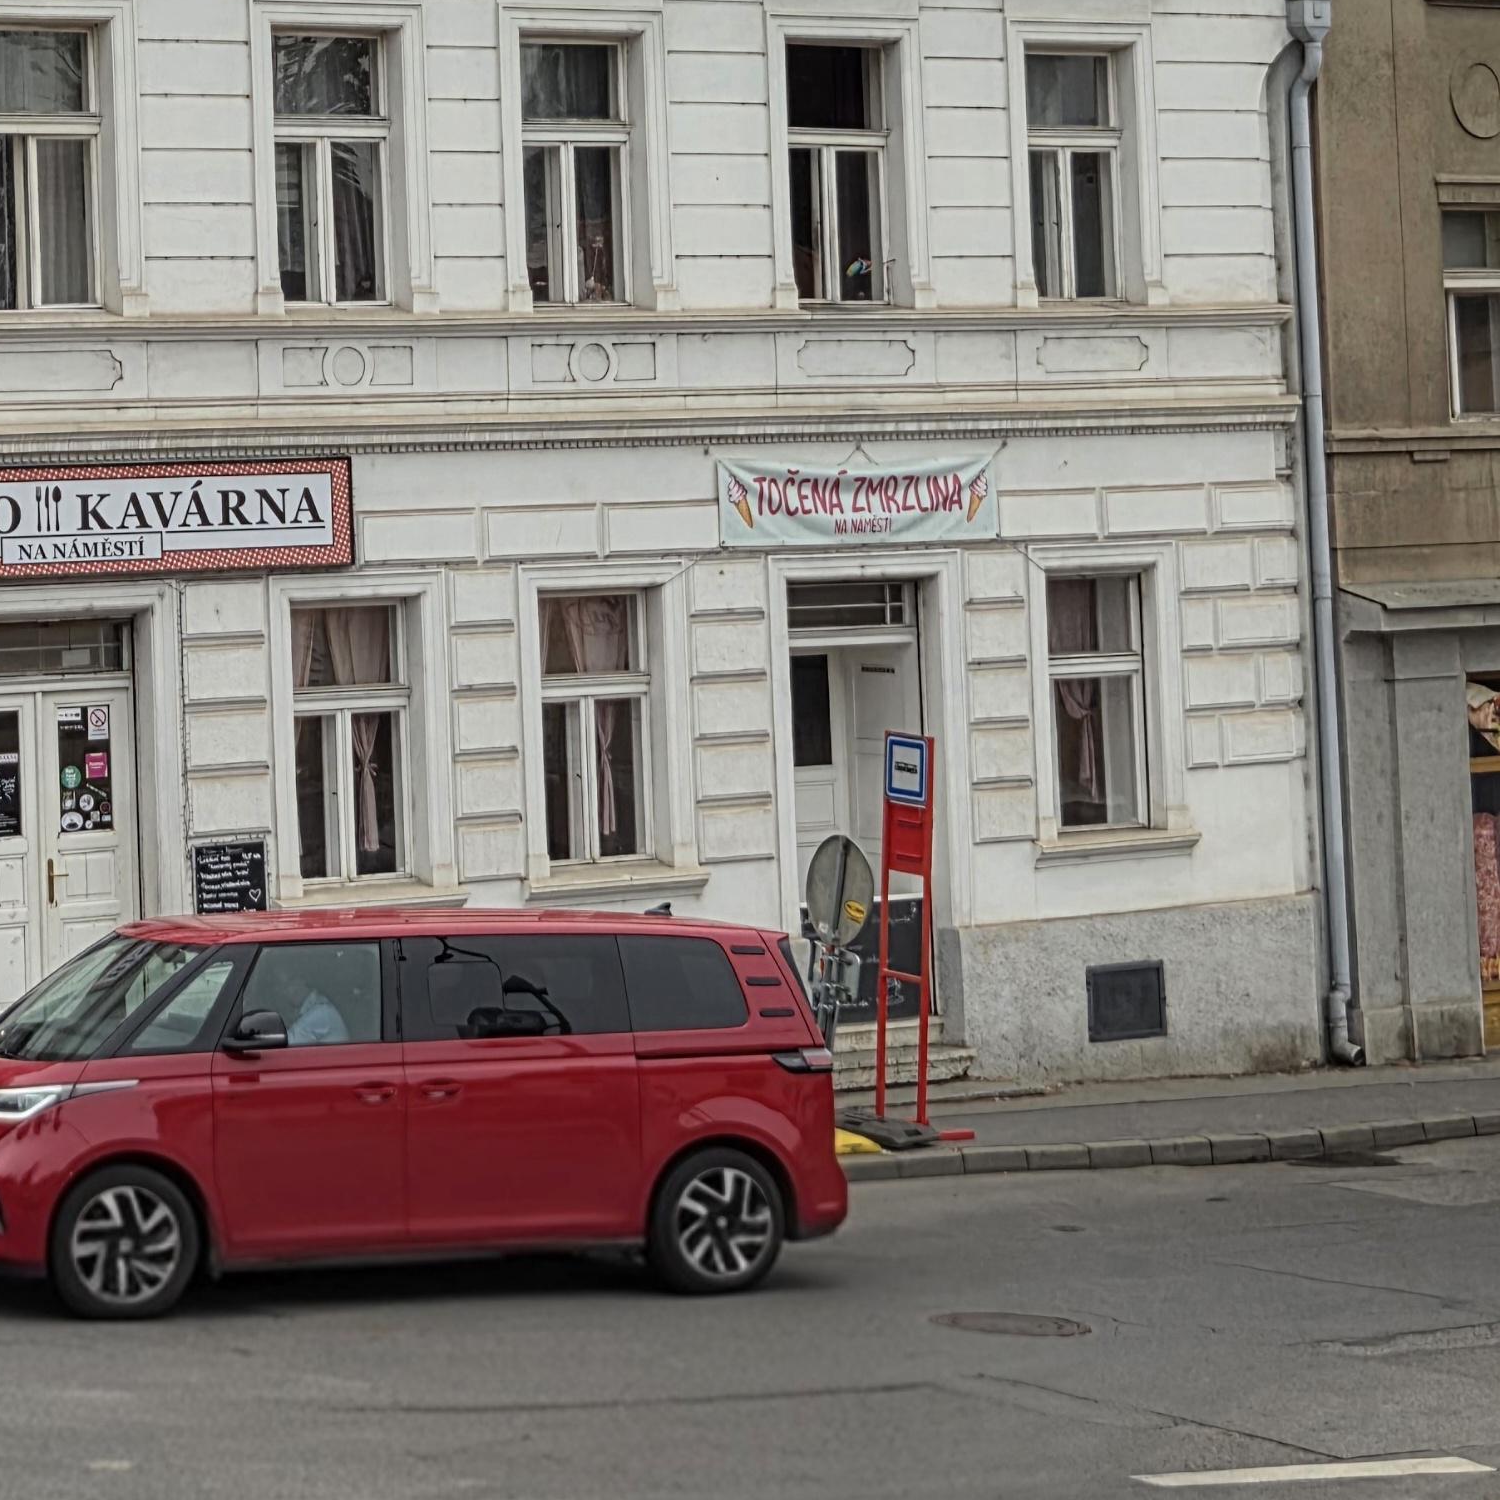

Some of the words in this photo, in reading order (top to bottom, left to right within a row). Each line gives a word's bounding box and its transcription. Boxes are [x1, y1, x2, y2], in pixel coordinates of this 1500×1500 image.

[76, 479, 326, 531] KAVÁRNA
[753, 469, 848, 516] TOČENÁ
[852, 473, 964, 513] ZMRZLINA
[834, 518, 847, 535] NA
[18, 541, 48, 561] NA
[52, 536, 145, 560] NÁMĚSTÍ
